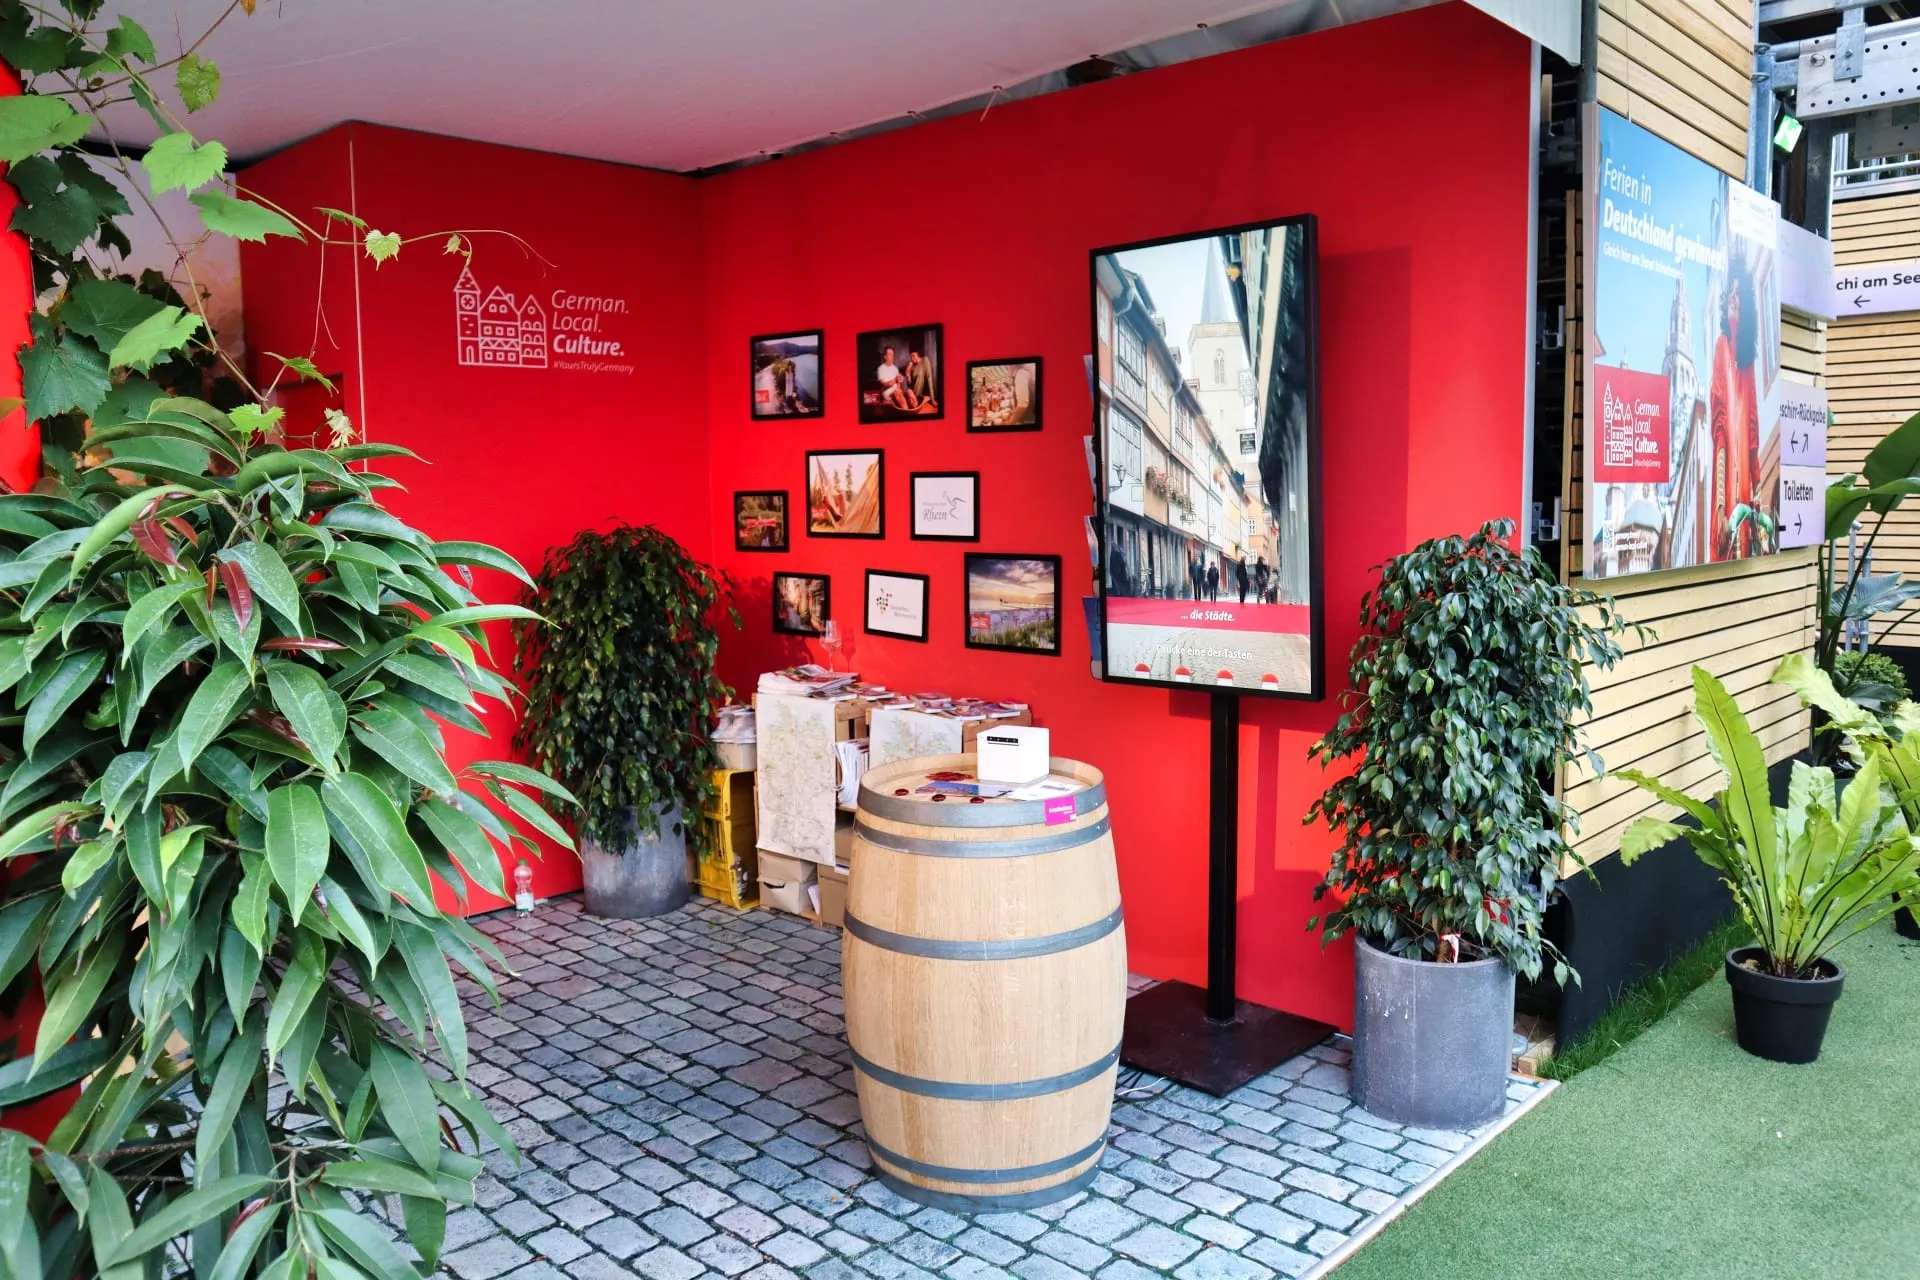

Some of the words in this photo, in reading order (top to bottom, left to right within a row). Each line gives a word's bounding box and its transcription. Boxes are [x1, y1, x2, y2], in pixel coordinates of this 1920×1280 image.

[1604, 157, 1638, 200] Ferien
[1641, 174, 1652, 206] in
[1603, 197, 1675, 252] Deutschland
[1836, 277, 1858, 290] chi
[1862, 277, 1887, 288] am
[1893, 273, 1920, 285] See
[551, 289, 629, 314] German.
[552, 311, 602, 333] Local.
[553, 334, 625, 356] Culture.
[1634, 398, 1660, 417] German.
[1780, 400, 1826, 427] schirr-Rückgabe
[1634, 417, 1652, 434] Local.
[1634, 436, 1659, 454] Culture.
[1783, 480, 1814, 502] Toiletten
[1190, 609, 1203, 620] die
[1187, 647, 1206, 657] eine
[1207, 647, 1222, 657] der
[1224, 648, 1253, 660] Tasten
